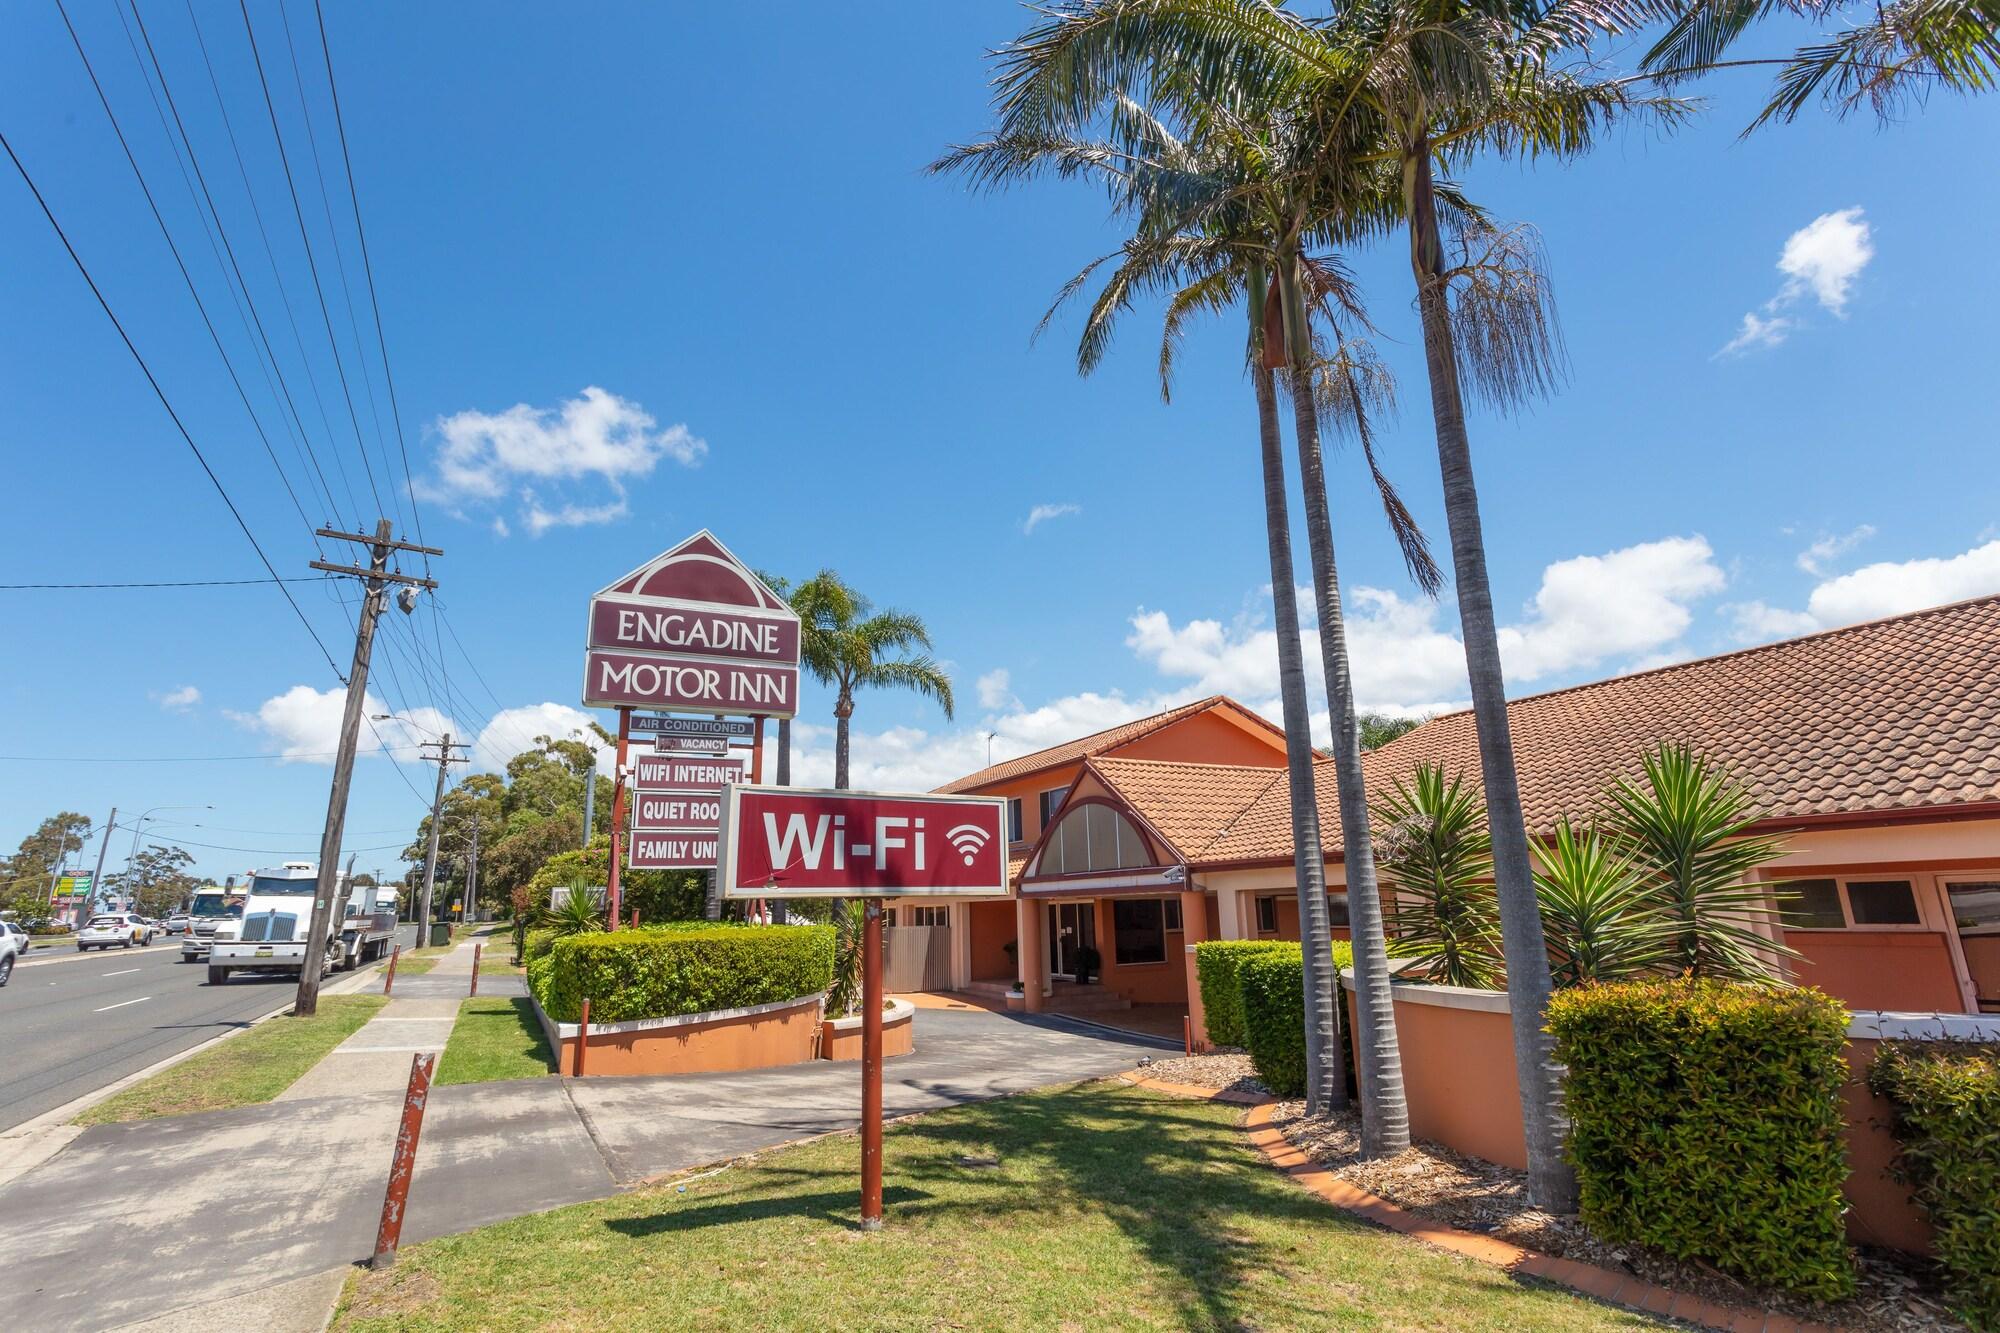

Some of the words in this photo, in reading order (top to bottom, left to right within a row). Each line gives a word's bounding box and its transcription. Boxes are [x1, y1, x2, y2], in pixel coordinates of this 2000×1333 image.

[617, 610, 780, 654] ENGADINE
[600, 661, 722, 700] MOTOR
[730, 672, 787, 704] INN
[639, 719, 660, 729] AIR
[664, 720, 745, 734] CONDITIONED
[680, 739, 725, 750] VACANCY
[640, 763, 670, 782] WIFI
[674, 765, 742, 784] INTERNET
[643, 801, 687, 820] QUIET
[690, 802, 720, 821] ROO
[637, 841, 688, 859] FAMILY
[692, 841, 719, 859] UNI
[762, 812, 925, 871] Wi-Fi
